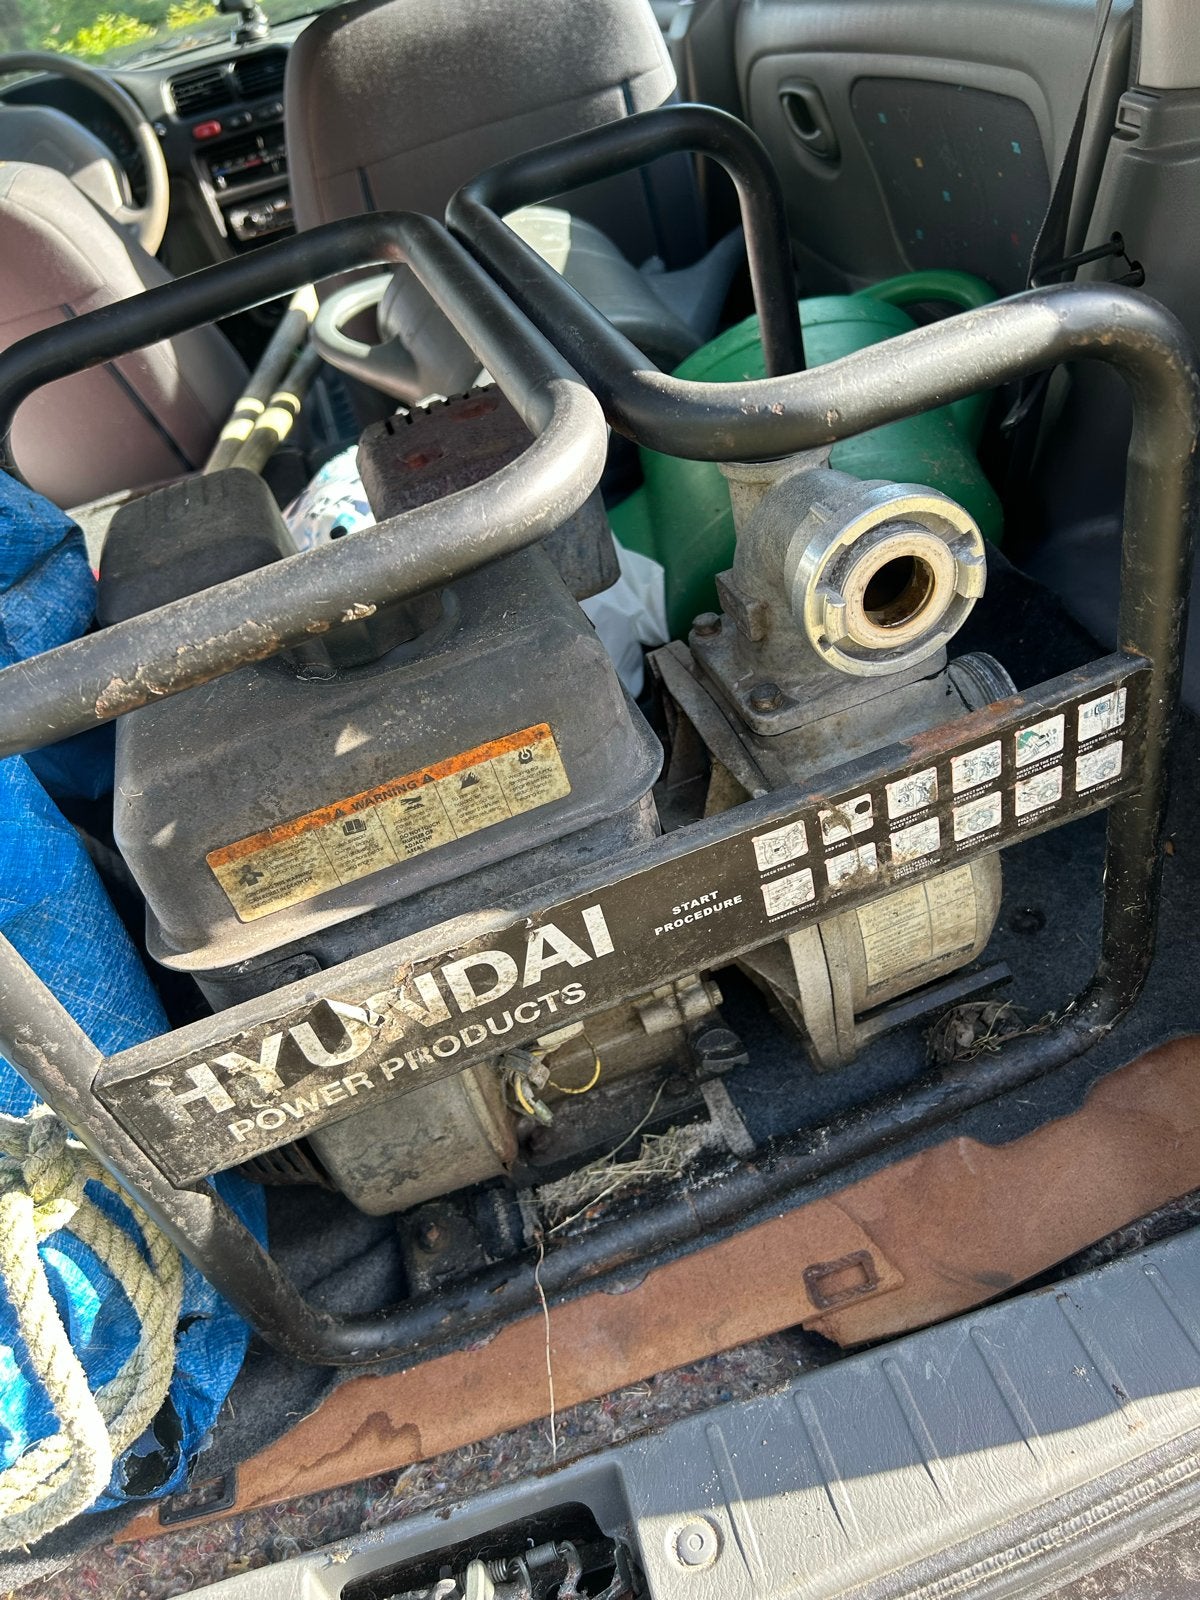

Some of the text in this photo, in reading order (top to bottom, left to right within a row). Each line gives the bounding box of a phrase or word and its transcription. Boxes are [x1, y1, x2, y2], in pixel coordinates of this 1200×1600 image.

[351, 780, 417, 811] WARNING
[654, 894, 743, 936] PROCEDURE
[672, 890, 719, 915] START
[156, 904, 615, 1124] HYUNDAI
[228, 982, 587, 1143] POWER PRODUCTS
